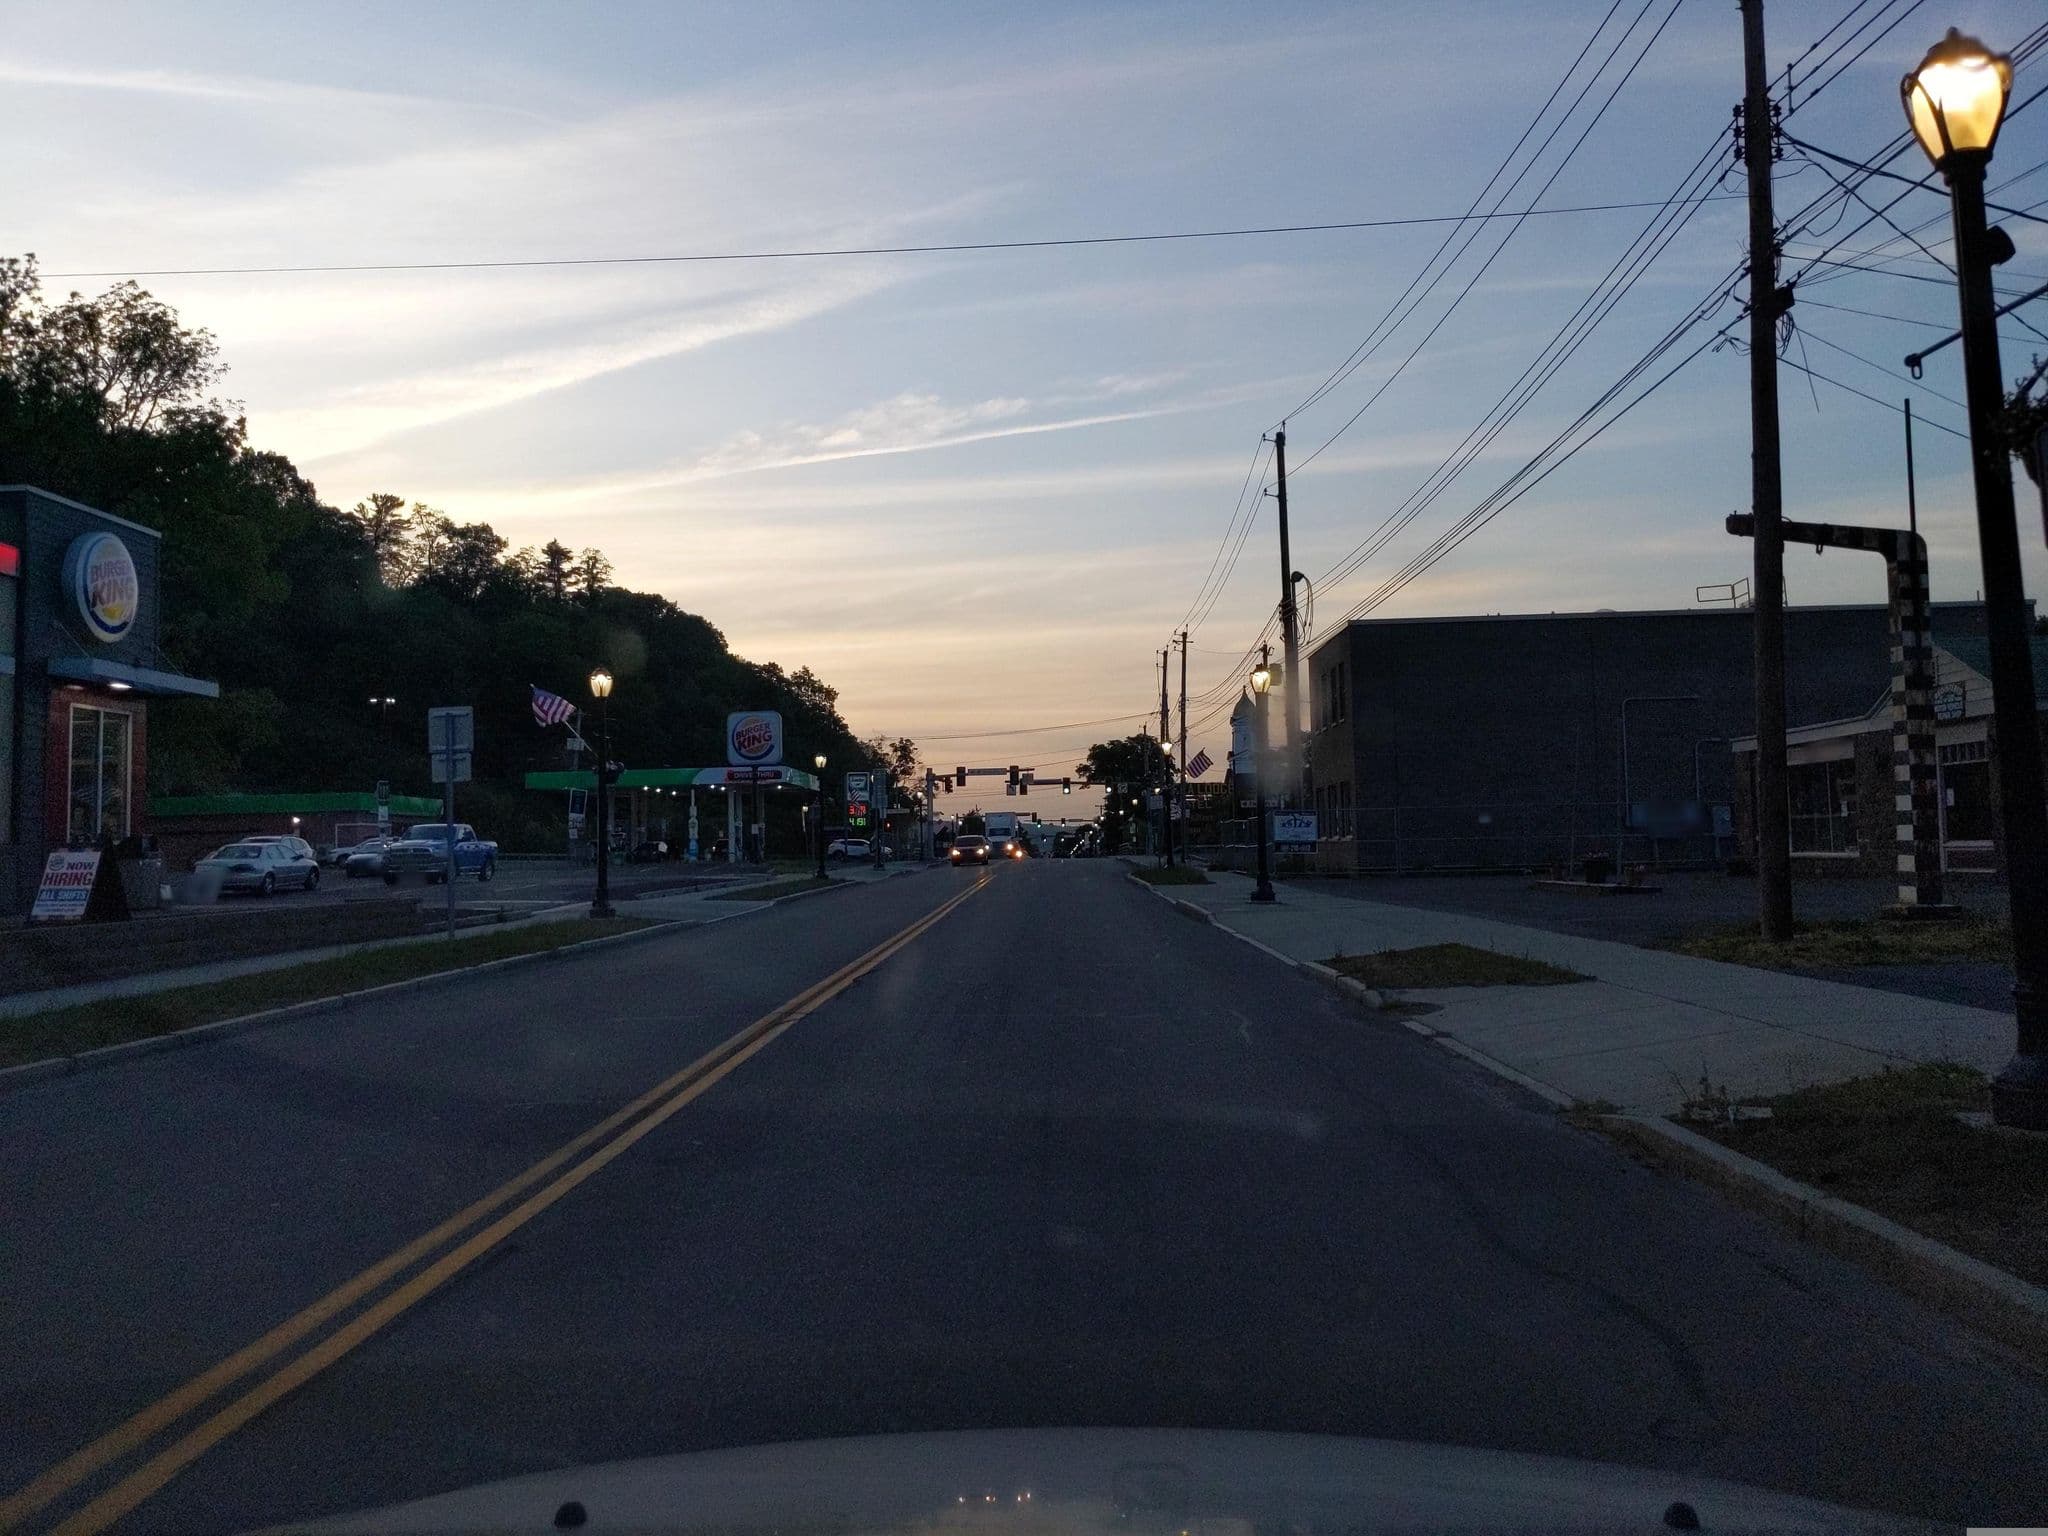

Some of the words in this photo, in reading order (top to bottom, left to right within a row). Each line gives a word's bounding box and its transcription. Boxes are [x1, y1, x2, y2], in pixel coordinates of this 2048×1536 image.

[91, 579, 134, 608] KING
[736, 722, 770, 741] BURGER
[738, 731, 772, 751] KING
[66, 862, 95, 871] NOW
[43, 872, 93, 886] HIRING
